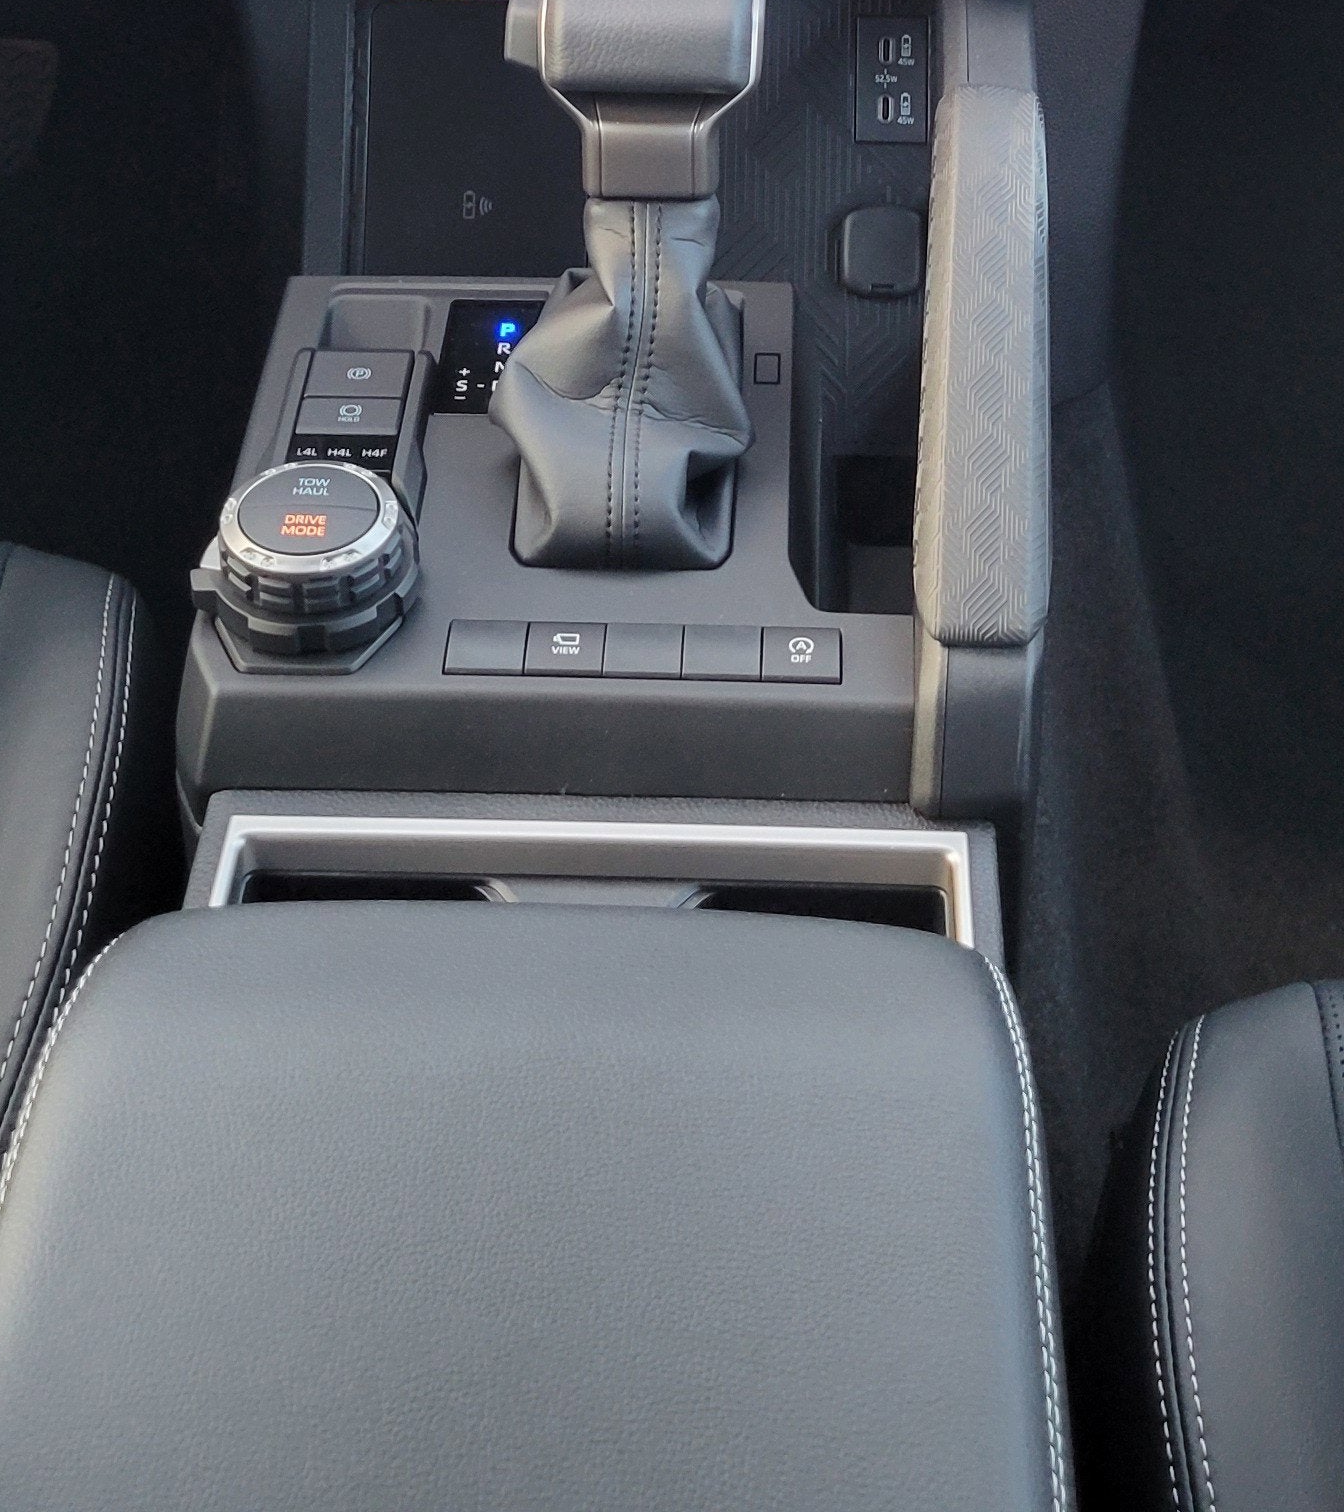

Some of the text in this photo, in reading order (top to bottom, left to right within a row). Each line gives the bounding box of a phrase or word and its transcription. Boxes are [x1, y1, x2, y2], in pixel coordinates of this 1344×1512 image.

[499, 322, 515, 337] P
[497, 342, 511, 355] R
[455, 379, 468, 392] S
[296, 447, 387, 458] L4L H4L H4F
[298, 477, 331, 487] TOW
[292, 486, 330, 496] HAUL
[285, 514, 327, 525] DRIVE
[280, 525, 325, 536] MODE
[552, 646, 580, 654] VIEW
[791, 655, 811, 663] OFF
